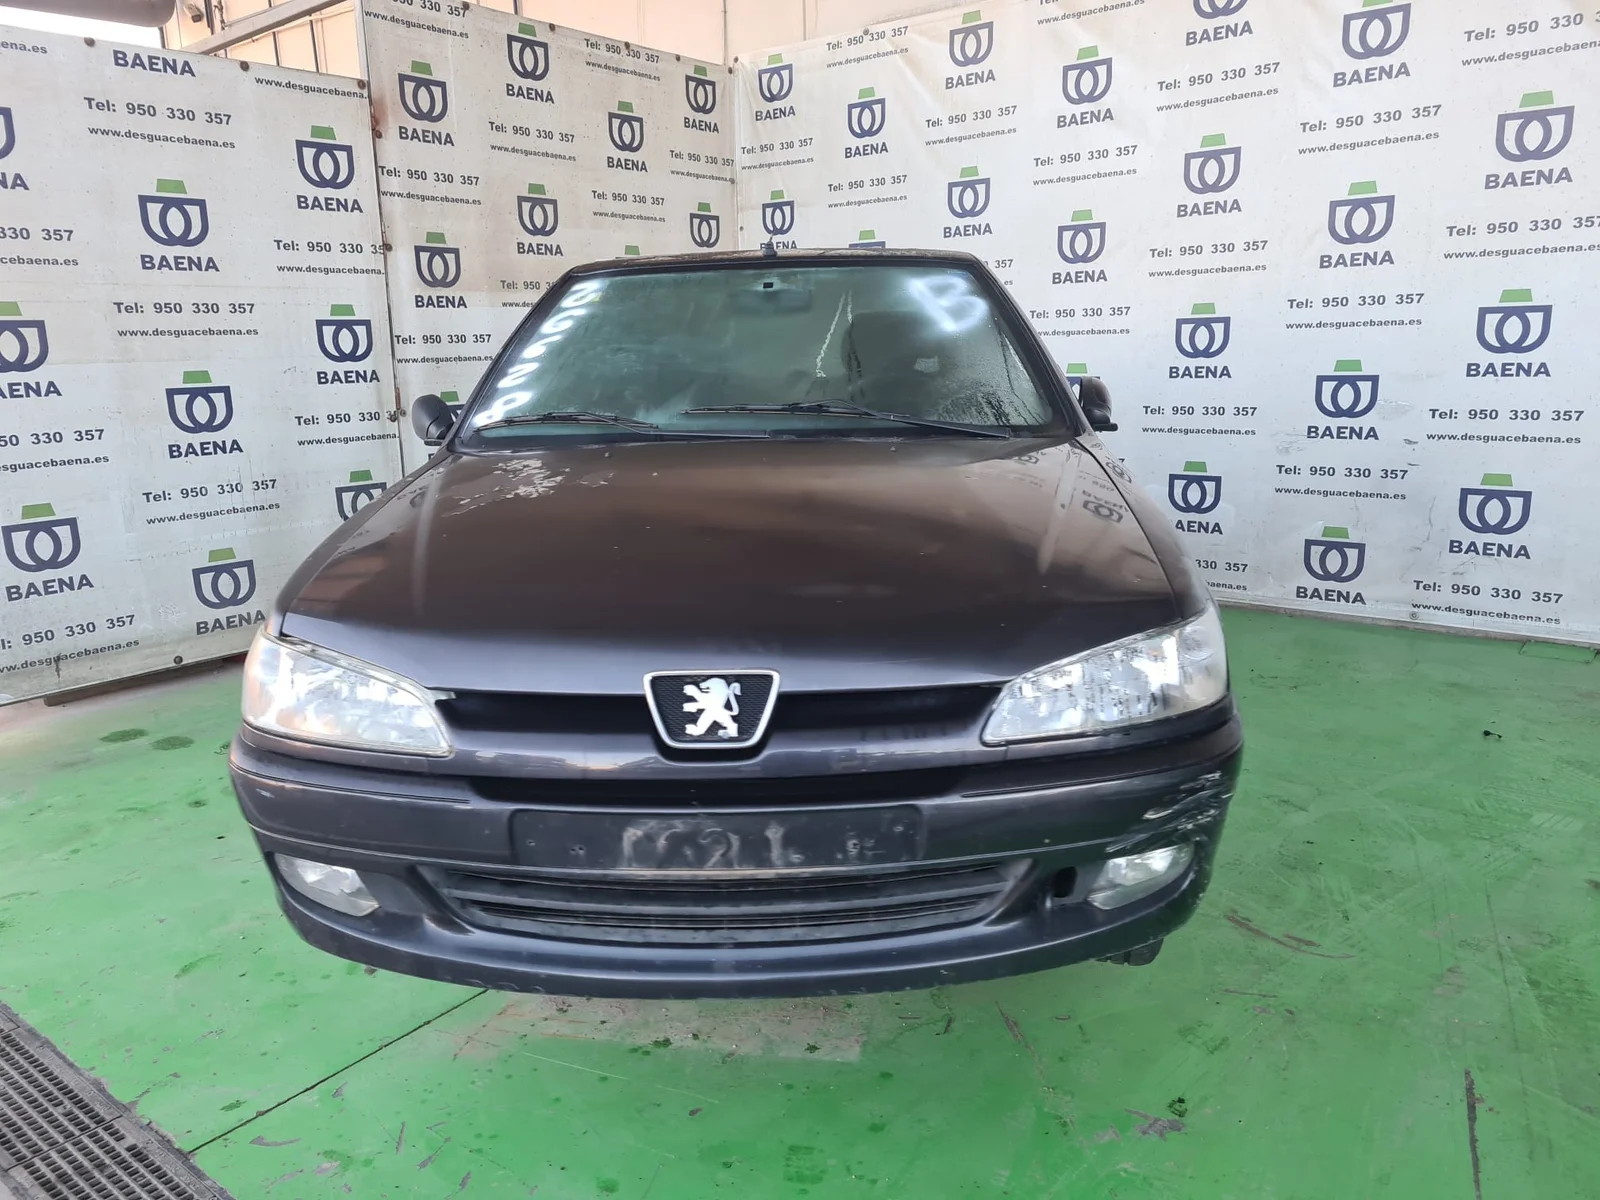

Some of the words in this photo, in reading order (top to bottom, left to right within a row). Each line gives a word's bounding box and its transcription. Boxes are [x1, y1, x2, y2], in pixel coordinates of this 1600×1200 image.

[420, 0, 441, 13] 330
[364, 10, 469, 39] www.desguacebaena.es
[1186, 20, 1253, 46] BAENA
[1464, 28, 1495, 42] Tel:
[1506, 20, 1539, 36] 950
[1550, 13, 1583, 29] 330
[826, 41, 842, 51] Tel:
[847, 35, 864, 46] 950
[869, 29, 886, 42] 330
[891, 26, 908, 37] 357
[584, 38, 601, 50] Tel:
[605, 42, 622, 55] 950
[625, 47, 641, 60] 330
[645, 52, 659, 64] 357
[827, 48, 908, 68] www.desguacebaena.es
[113, 49, 196, 77] BAENA
[585, 61, 660, 81] www.desguacebaena.es
[945, 69, 996, 90] BAENA
[1157, 79, 1181, 91] Tel:
[1188, 73, 1213, 86] 950
[1221, 67, 1246, 81] 330
[1254, 62, 1280, 76] 357
[1333, 62, 1411, 87] BAENA
[506, 83, 555, 104] BAENA
[1156, 89, 1278, 112] www.desguacebaena.es
[83, 97, 116, 112] Tel:
[126, 102, 157, 117] 950
[166, 107, 196, 121] 330
[204, 112, 232, 125] 357
[755, 105, 796, 121] BAENA
[925, 118, 942, 128] Tel:
[948, 113, 966, 124] 950
[973, 110, 991, 121] 330
[998, 105, 1017, 117] 357
[1057, 108, 1114, 128] BAENA
[1300, 120, 1327, 133] Tel:
[1336, 115, 1364, 128] 950
[1373, 110, 1402, 124] 330
[1412, 104, 1442, 119] 357
[488, 121, 507, 133] Tel:
[512, 125, 531, 137] 950
[536, 129, 554, 140] 330
[559, 132, 575, 143] 357
[684, 116, 719, 134] BAENA
[88, 127, 235, 149] www.desguacebaena.es
[398, 125, 455, 147] BAENA
[925, 128, 1016, 146] www.desguacebaena.es
[1298, 132, 1439, 155] www.desguacebaena.es
[490, 144, 576, 162] www.desguacebaena.es
[669, 150, 684, 160] Tel:
[687, 152, 701, 162] 950
[705, 155, 718, 165] 330
[721, 158, 734, 167] 357
[845, 142, 889, 159] BAENA
[1033, 156, 1053, 167] Tel:
[1060, 152, 1081, 164] 950
[1088, 149, 1109, 160] 330
[1116, 145, 1138, 157] 357
[607, 156, 648, 173] BAENA
[379, 165, 401, 178] Tel:
[407, 169, 427, 181] 950
[433, 172, 454, 184] 330
[460, 175, 479, 186] 357
[1033, 169, 1137, 185] www.desguacebaena.es
[1484, 167, 1573, 190] BAENA
[296, 194, 364, 213] BAENA
[380, 189, 482, 205] www.desguacebaena.es
[591, 190, 607, 200] Tel:
[612, 192, 627, 202] 950
[632, 194, 647, 204] 330
[651, 196, 665, 206] 357
[828, 195, 907, 208] www.desguacebaena.es
[593, 211, 665, 222] www.desguacebaena.es
[1177, 199, 1242, 218] BAENA
[41, 228, 74, 241] 357
[943, 223, 993, 238] BAENA
[1446, 225, 1476, 237] Tel:
[1487, 221, 1518, 234] 950
[1529, 218, 1562, 231] 330
[273, 239, 299, 251] Tel:
[307, 241, 332, 253] 950
[339, 242, 363, 254] 330
[517, 242, 564, 257] BAENA
[1149, 248, 1172, 258] Tel:
[1180, 245, 1203, 256] 950
[1211, 243, 1235, 254] 330
[1243, 240, 1268, 252] 357
[140, 254, 220, 272] BAENA
[1319, 250, 1394, 269] BAENA
[1052, 269, 1108, 285] BAENA
[1148, 265, 1266, 277] www.desguacebaena.es
[500, 280, 518, 290] Tel:
[523, 281, 540, 290] 950
[113, 302, 144, 314] Tel:
[153, 302, 183, 314] 950
[191, 302, 220, 314] 330
[228, 303, 255, 314] 357
[414, 294, 468, 309] BAENA
[1029, 310, 1049, 319] Tel:
[1055, 308, 1075, 318] 950
[1082, 307, 1102, 317] 330
[1109, 306, 1131, 316] 357
[117, 327, 259, 338] www.desguacebaena.es
[1286, 319, 1422, 330] www.desguacebaena.es
[394, 335, 416, 345] Tel:
[422, 334, 442, 344] 950
[447, 334, 467, 344] 330
[472, 334, 491, 343] 357
[397, 355, 493, 365] www.desguacebaena.es
[316, 369, 380, 385] BAENA
[1169, 365, 1232, 379] BAENA
[1466, 362, 1551, 377] BAENA
[1143, 405, 1165, 415] Tel:
[1172, 406, 1195, 416] 950
[1202, 406, 1225, 416] 330
[1233, 406, 1257, 416] 357
[1429, 408, 1458, 419] Tel:
[1468, 409, 1499, 420] 950
[1509, 409, 1541, 421] 330
[1551, 410, 1584, 421] 357
[30, 431, 63, 445] 330
[73, 428, 104, 442] 357
[1142, 426, 1256, 435] www.desguacebaena.es
[1306, 425, 1379, 440] BAENA
[1426, 433, 1581, 444] www.desguacebaena.es
[168, 439, 244, 459] BAENA
[142, 490, 172, 503] Tel:
[180, 486, 208, 499] 950
[217, 482, 243, 495] 330
[252, 479, 277, 491] 357
[1274, 487, 1406, 500] www.desguacebaena.es
[146, 503, 280, 525] www.desguacebaena.es
[1175, 519, 1223, 535] AENA
[1448, 539, 1531, 560] BAENA
[1225, 562, 1248, 573] 357
[5, 574, 94, 602] BAENA
[1296, 586, 1366, 605] BAENA
[1413, 580, 1441, 592] Tel:
[1451, 583, 1481, 596] 950
[1490, 587, 1521, 600] 330
[1531, 591, 1563, 604] 357
[1411, 603, 1560, 624] www.desguacebaena.es
[22, 629, 55, 645] 950
[65, 622, 96, 637] 330
[106, 614, 135, 629] 357
[196, 610, 266, 636] BAENA
